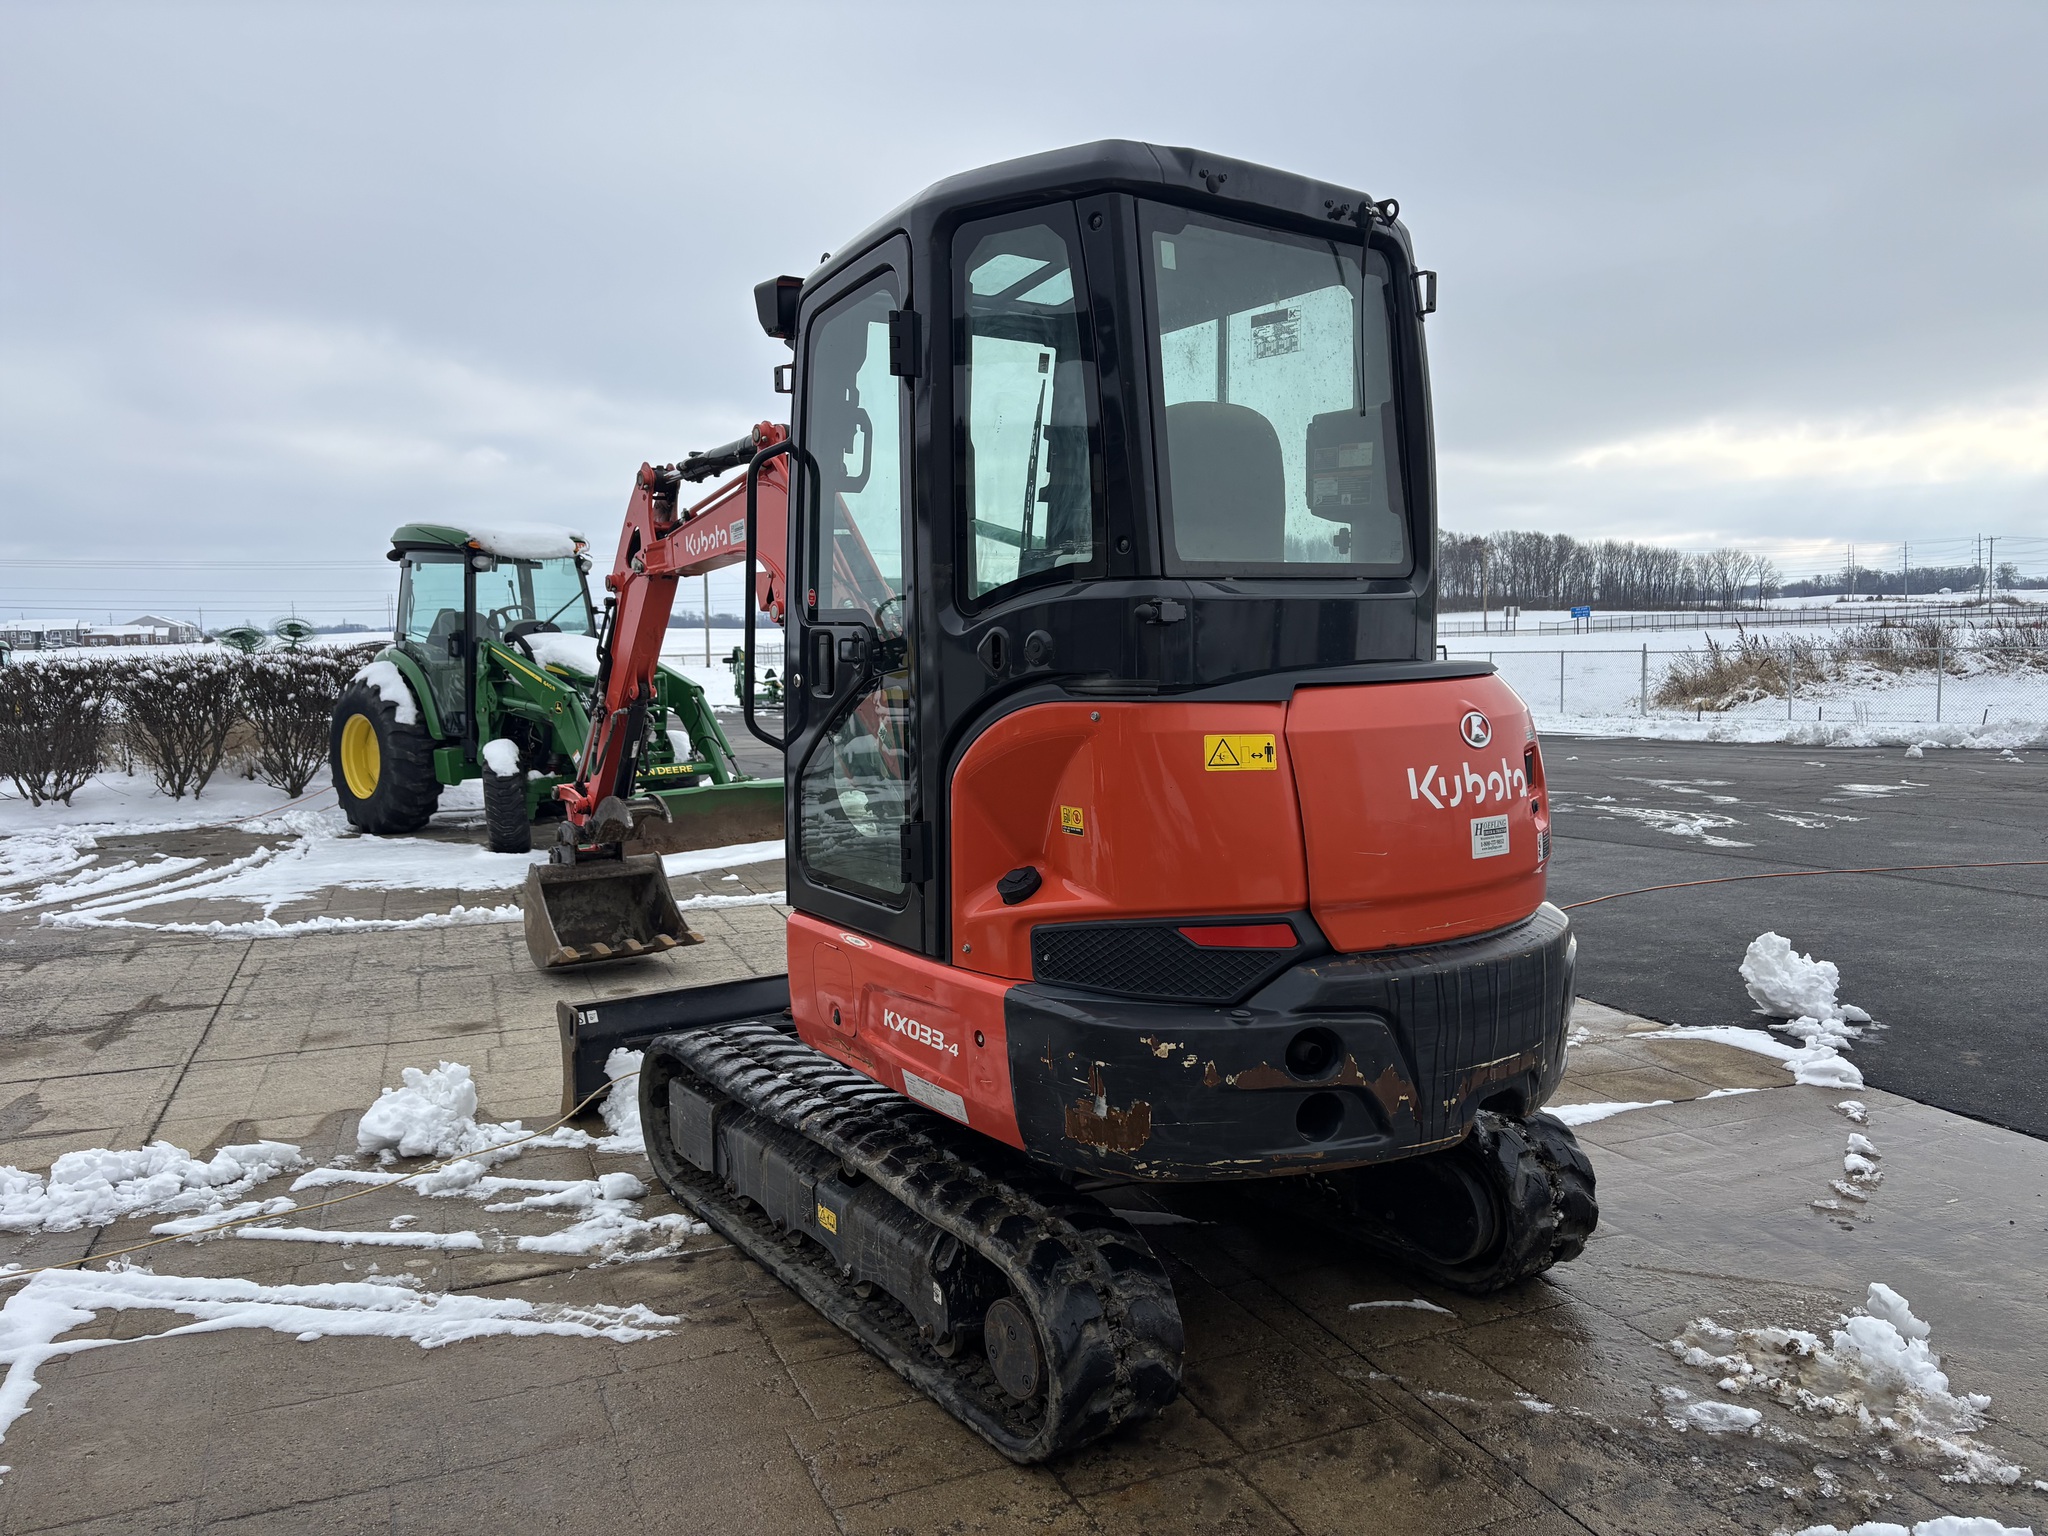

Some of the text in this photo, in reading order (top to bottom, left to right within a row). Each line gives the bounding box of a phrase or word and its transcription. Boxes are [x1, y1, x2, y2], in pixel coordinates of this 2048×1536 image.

[685, 525, 728, 556] Kubota
[656, 764, 694, 775] DEERE
[1407, 758, 1528, 809] Kubota
[883, 1008, 959, 1057] KX033-4
